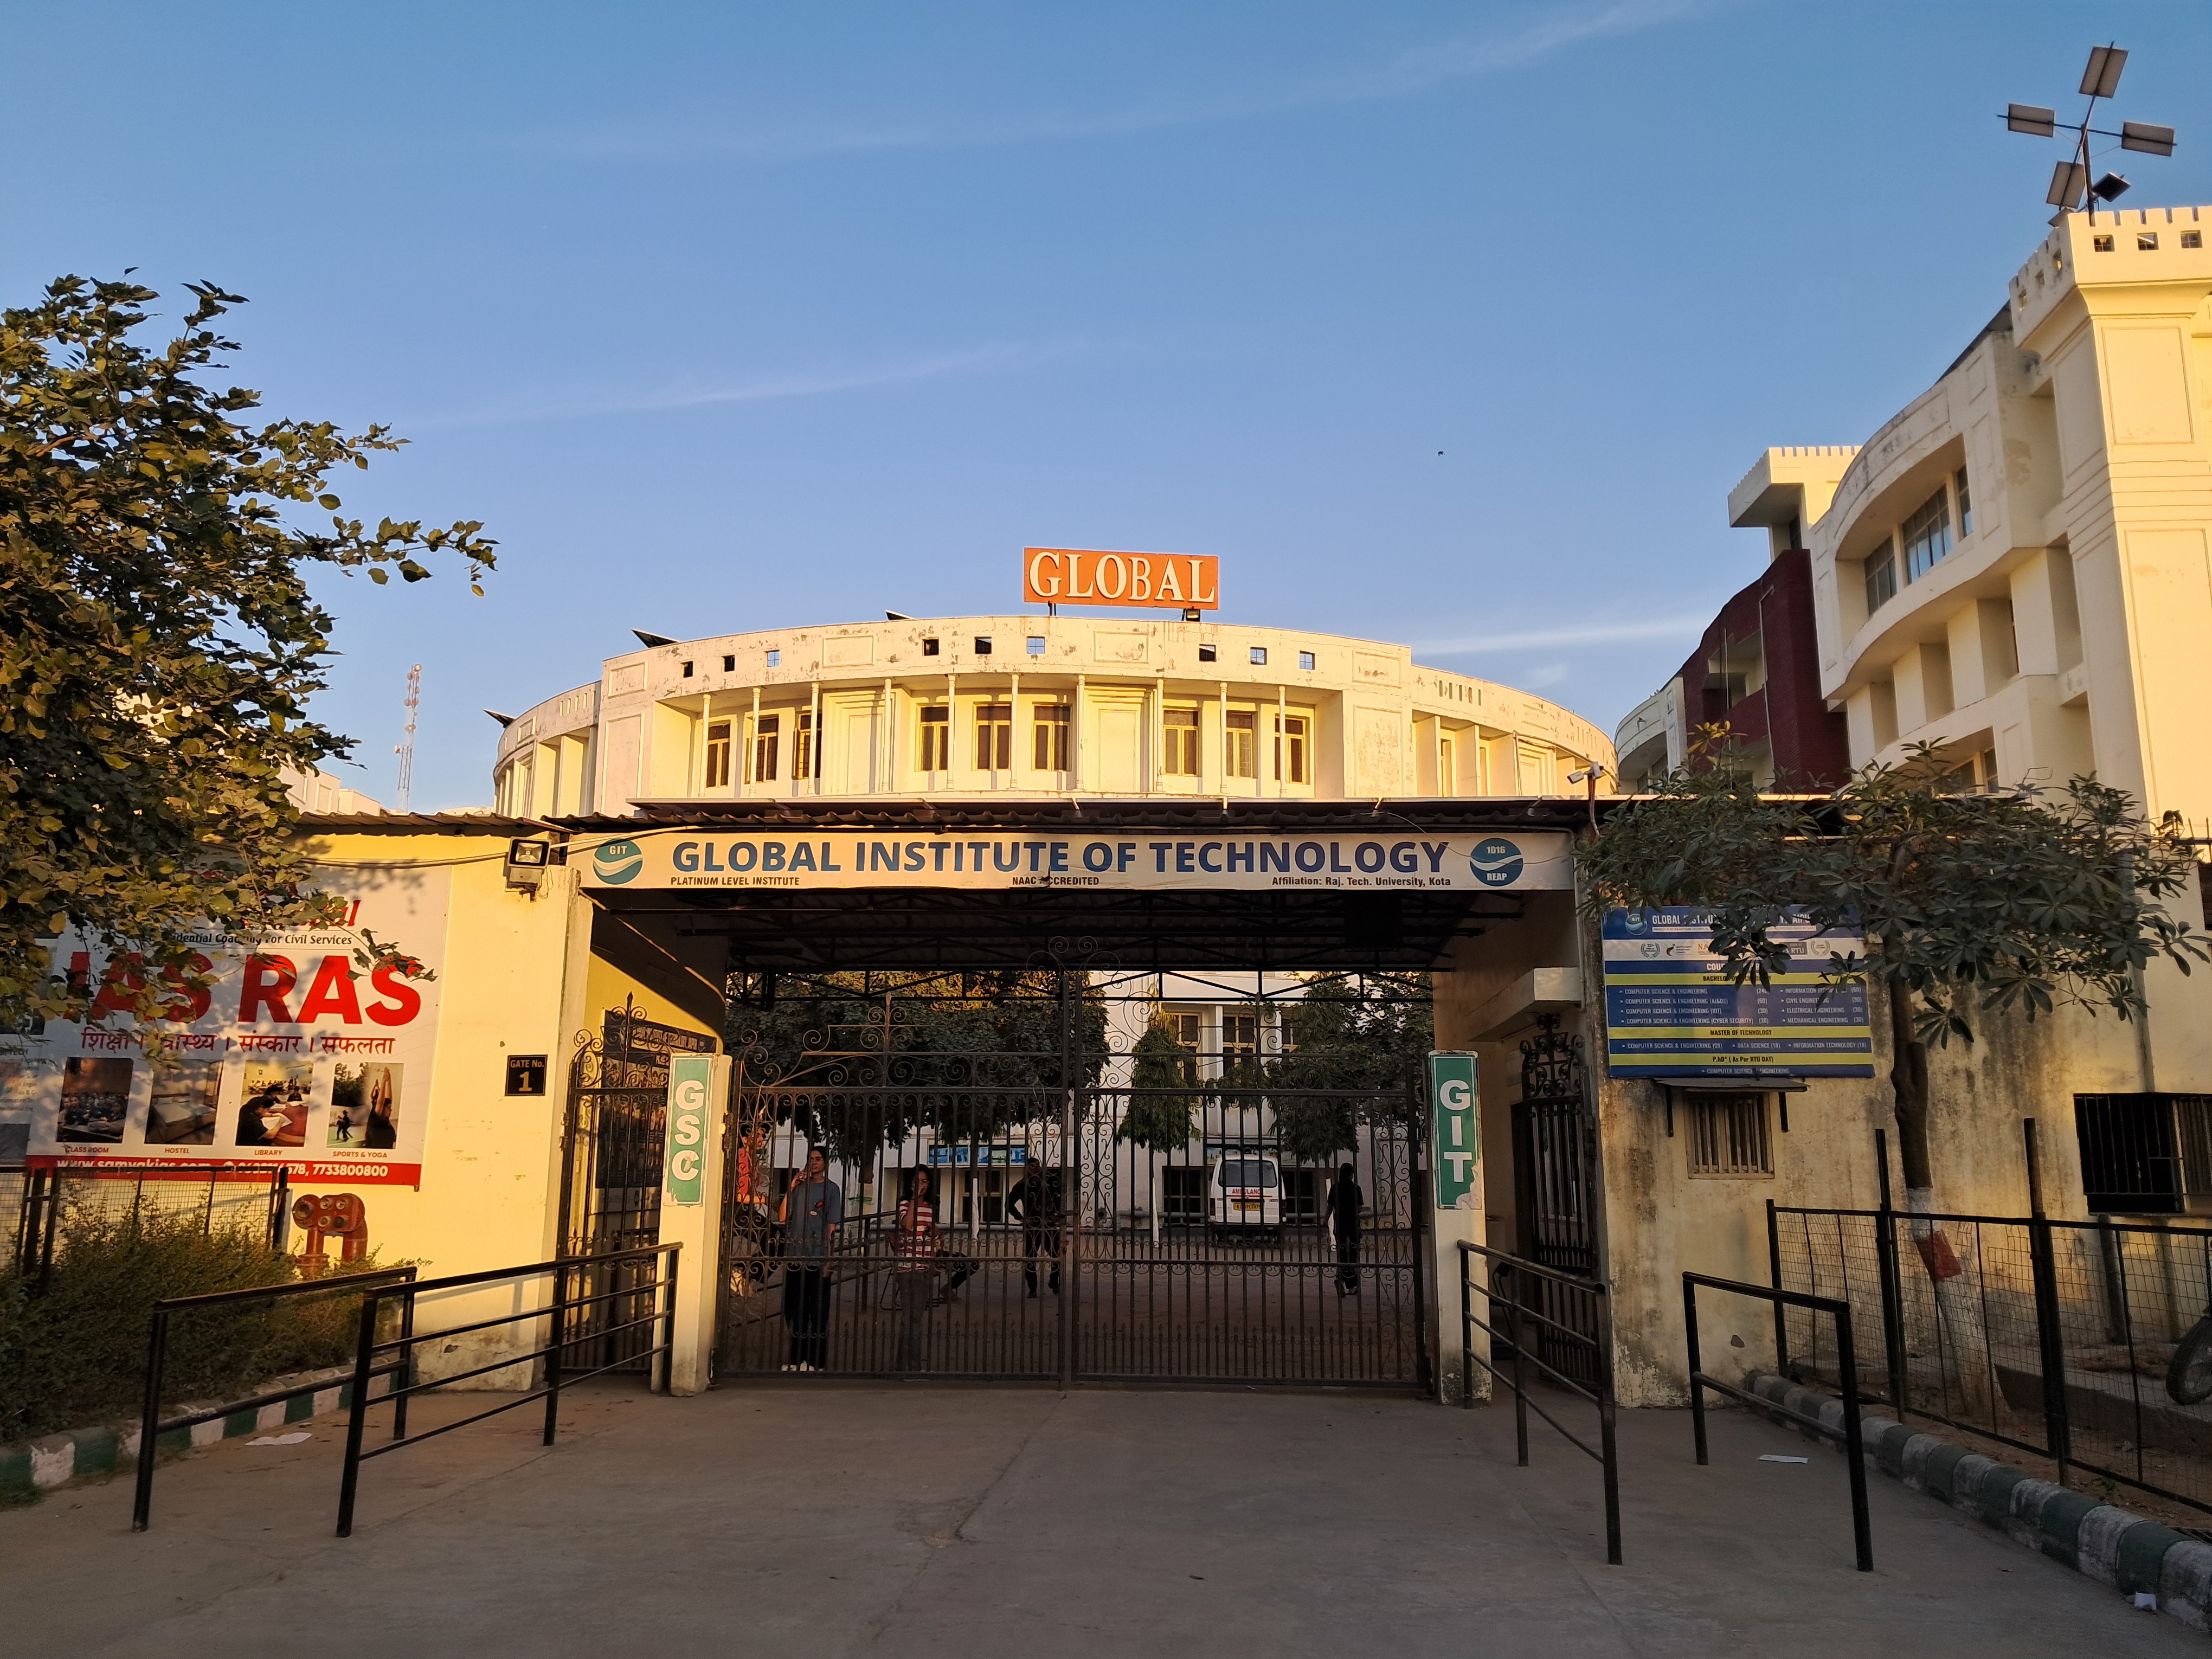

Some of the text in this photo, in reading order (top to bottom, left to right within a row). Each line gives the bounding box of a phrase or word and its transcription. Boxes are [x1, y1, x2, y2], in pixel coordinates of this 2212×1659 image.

[1030, 551, 1215, 603] GLOBAL
[609, 845, 628, 855] GIT
[1486, 846, 1506, 854] 1016
[673, 841, 1449, 873] GLOBAL INSTITUTE OF TECHNOLOGY
[671, 877, 800, 885] PLATINUM LEVEL INSTITUTE
[1012, 877, 1037, 885] NAAC
[1272, 877, 1451, 888] Affiliation: Raj. Tech. University, Kota
[1487, 873, 1508, 881] REAP
[1652, 915, 1681, 924] GLOBAL
[167, 933, 212, 943] idential
[216, 934, 261, 945] Coacing
[285, 934, 306, 944] Civil
[310, 934, 352, 945] Services
[238, 955, 421, 1026] RAS
[237, 1029, 303, 1053] संस्कार
[320, 1036, 396, 1054] सफलता
[510, 1059, 544, 1068] GATE No.
[518, 1071, 532, 1092] 1
[672, 1081, 704, 1181] GSC
[1439, 1079, 1472, 1182] GIT
[313, 1163, 388, 1177] 7733800800
